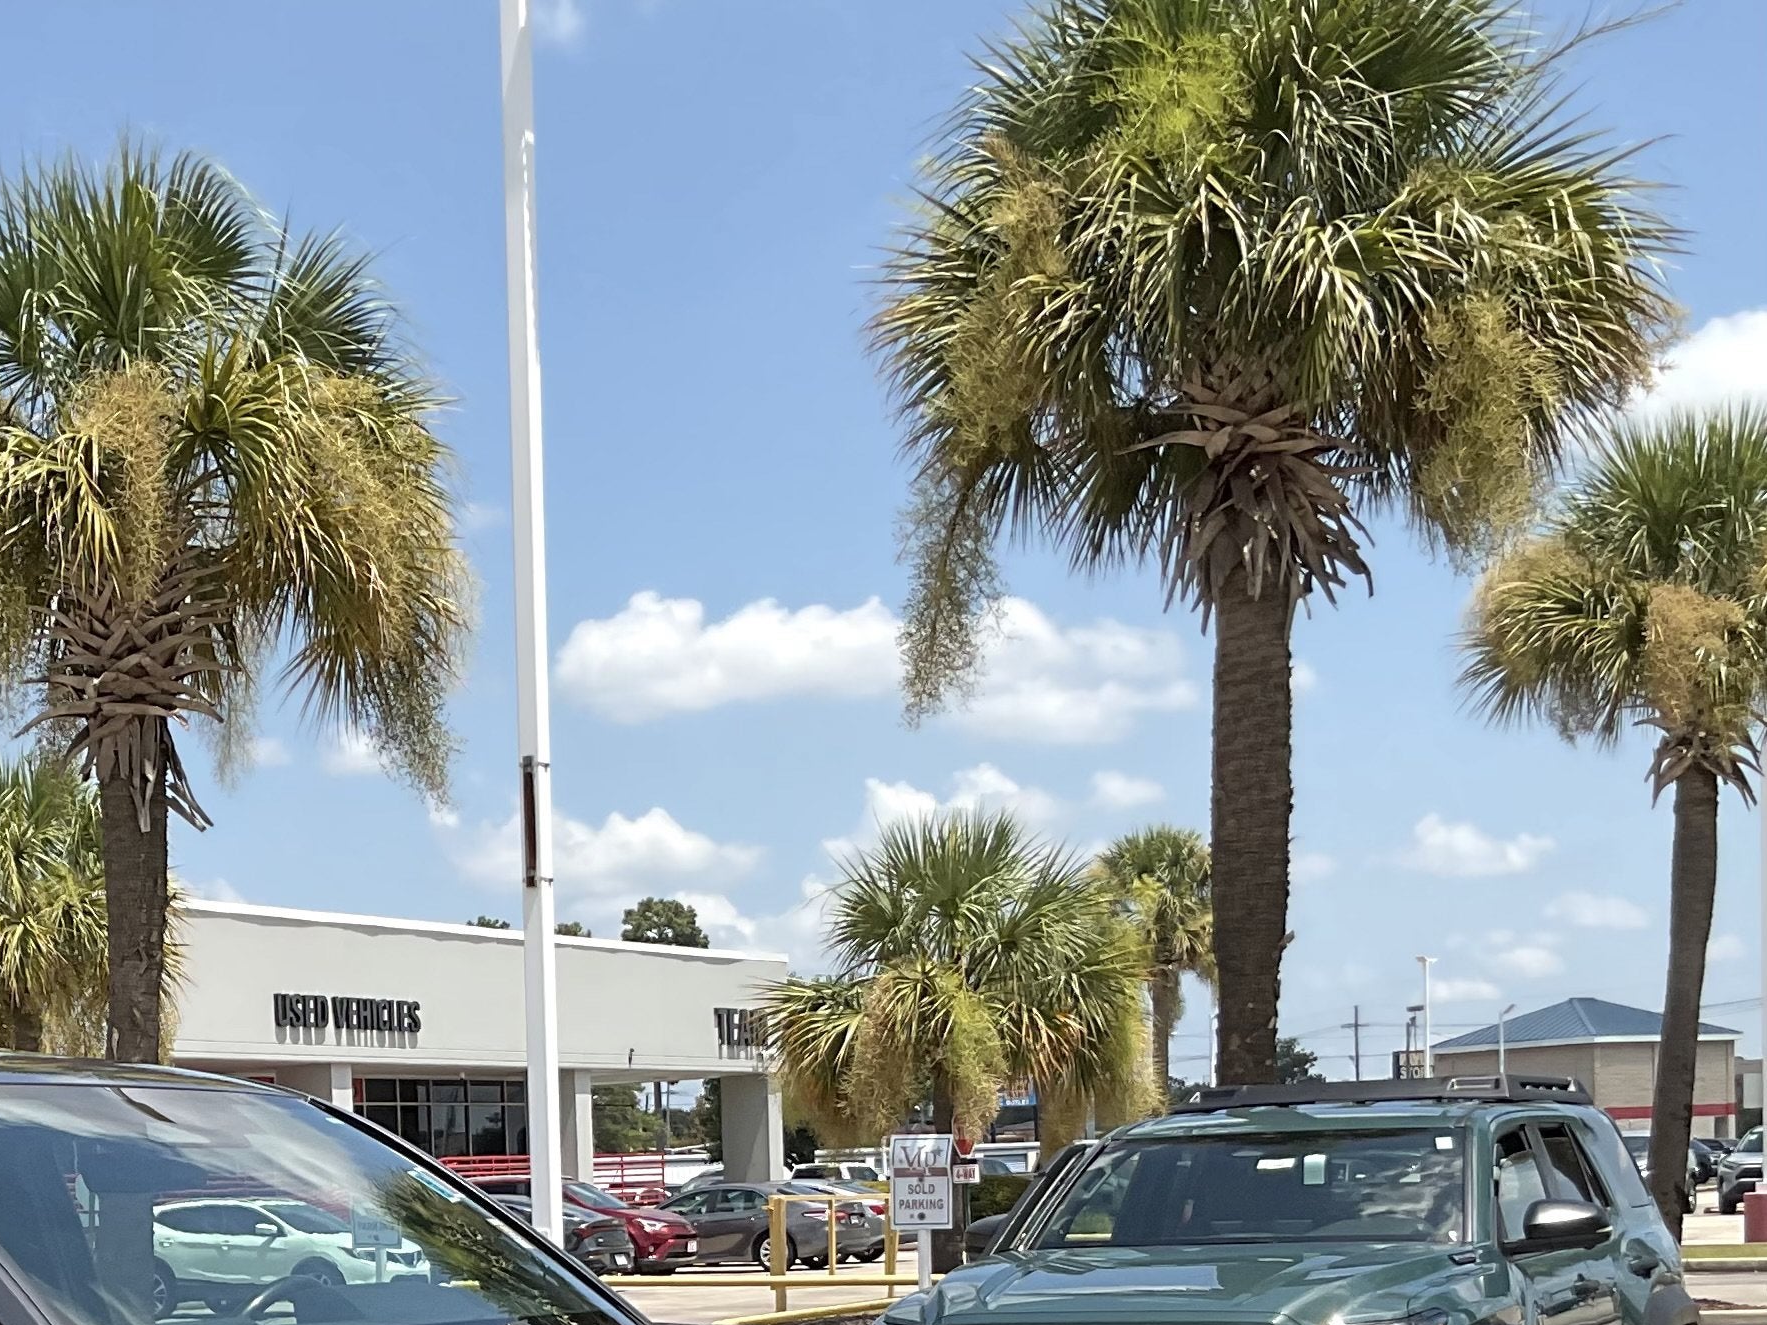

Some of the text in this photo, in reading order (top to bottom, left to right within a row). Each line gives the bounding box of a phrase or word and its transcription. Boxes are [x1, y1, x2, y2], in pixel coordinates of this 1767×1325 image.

[273, 993, 421, 1033] USED VEHICLES
[955, 1168, 976, 1180] 4-WAY
[907, 1183, 936, 1195] SOLD
[898, 1199, 945, 1210] PARKING
